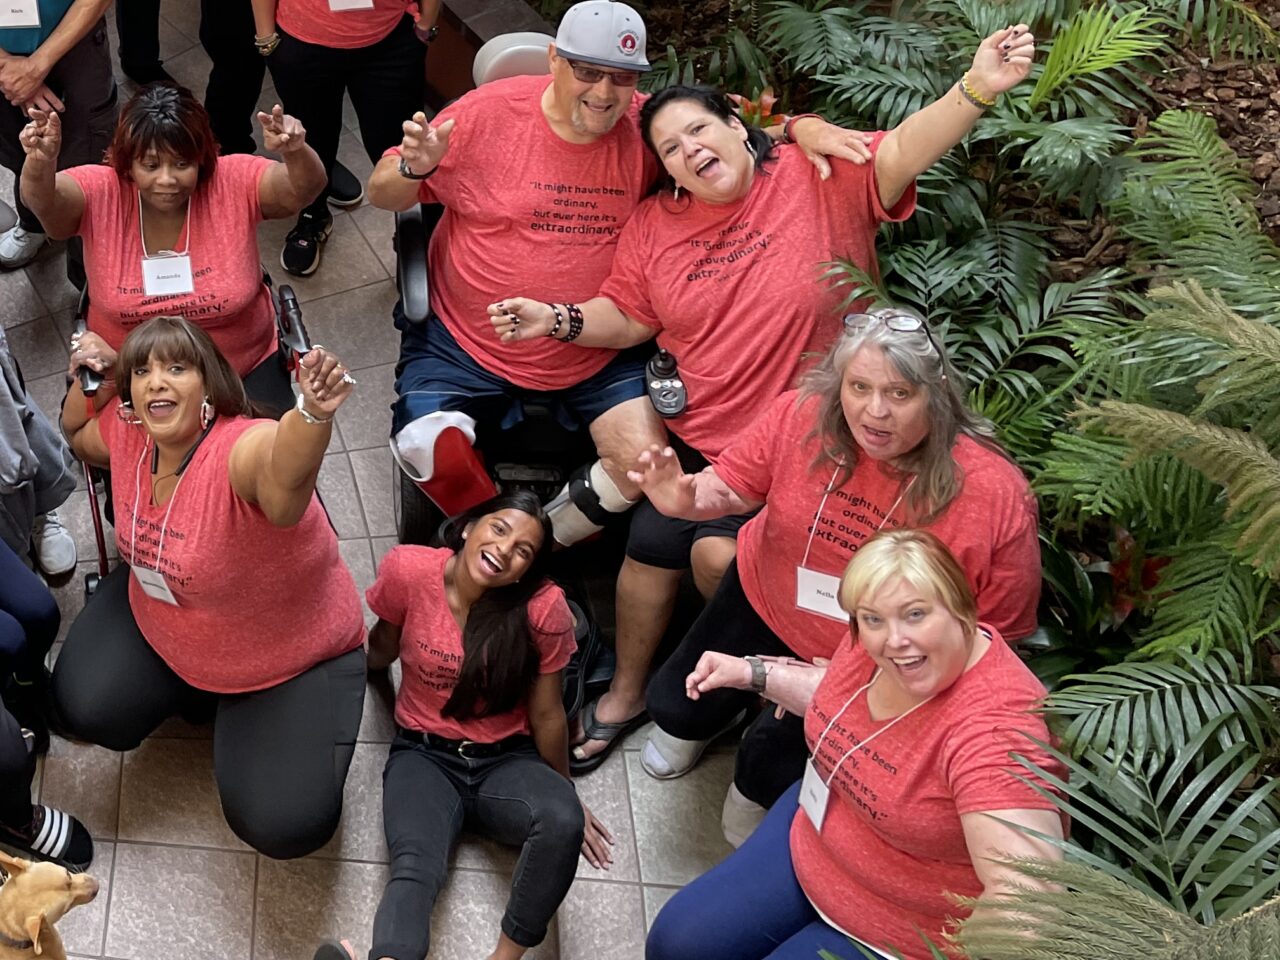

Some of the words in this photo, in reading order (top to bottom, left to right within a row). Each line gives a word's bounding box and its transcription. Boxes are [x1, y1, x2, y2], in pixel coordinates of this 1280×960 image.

[530, 181, 542, 189] "It
[544, 184, 573, 193] might
[574, 185, 601, 194] have
[603, 186, 625, 196] been
[533, 209, 551, 218] but
[577, 213, 600, 222] here
[601, 213, 617, 222] it's
[192, 266, 212, 279] een
[172, 300, 197, 311] here
[198, 293, 216, 304] it's
[836, 490, 872, 510] might
[842, 509, 880, 531] ordina
[170, 527, 186, 540] bee
[838, 524, 868, 540] over
[416, 640, 429, 652] "It
[429, 649, 461, 662] might
[817, 710, 847, 737] miht
[872, 752, 898, 776] been
[861, 783, 879, 802] it's
